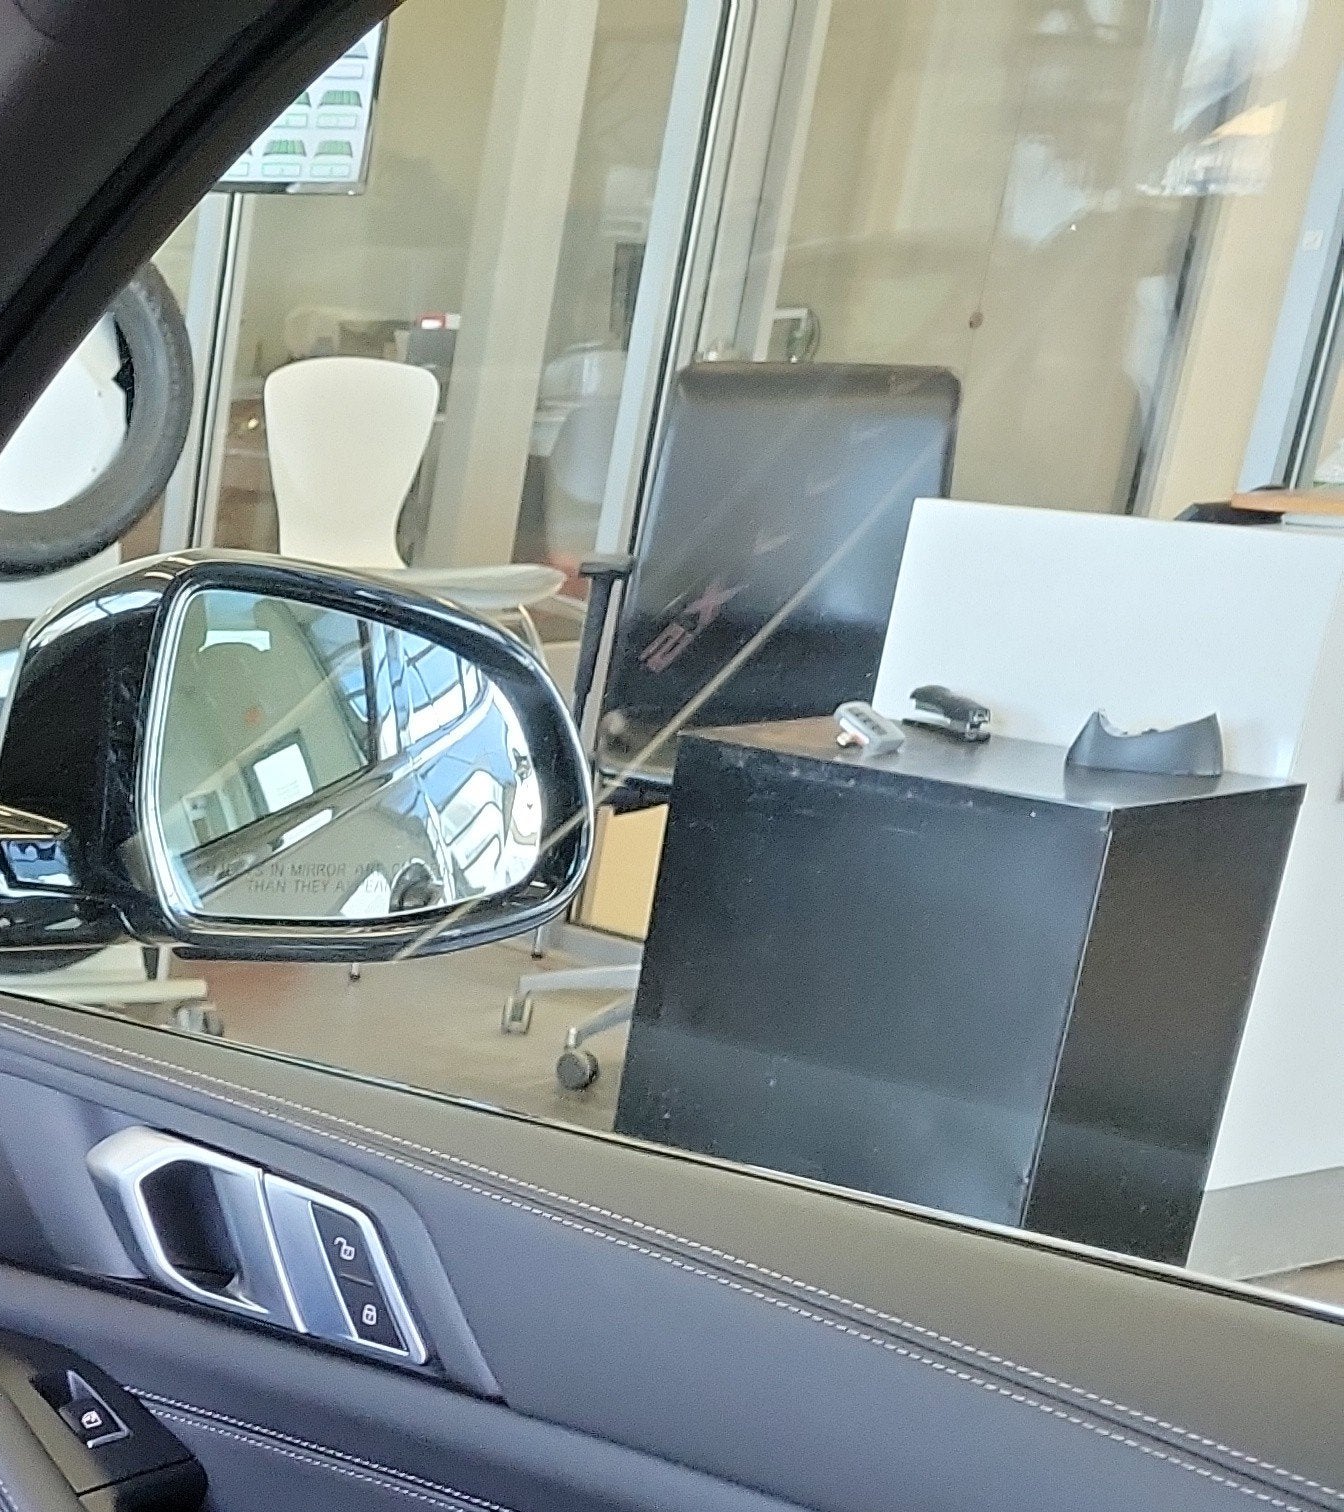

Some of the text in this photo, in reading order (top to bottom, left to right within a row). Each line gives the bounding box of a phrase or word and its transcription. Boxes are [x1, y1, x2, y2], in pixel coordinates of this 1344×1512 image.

[269, 862, 285, 877] IN
[290, 862, 347, 878] MIRROR
[247, 878, 287, 894] THAN
[293, 878, 329, 894] THEY
